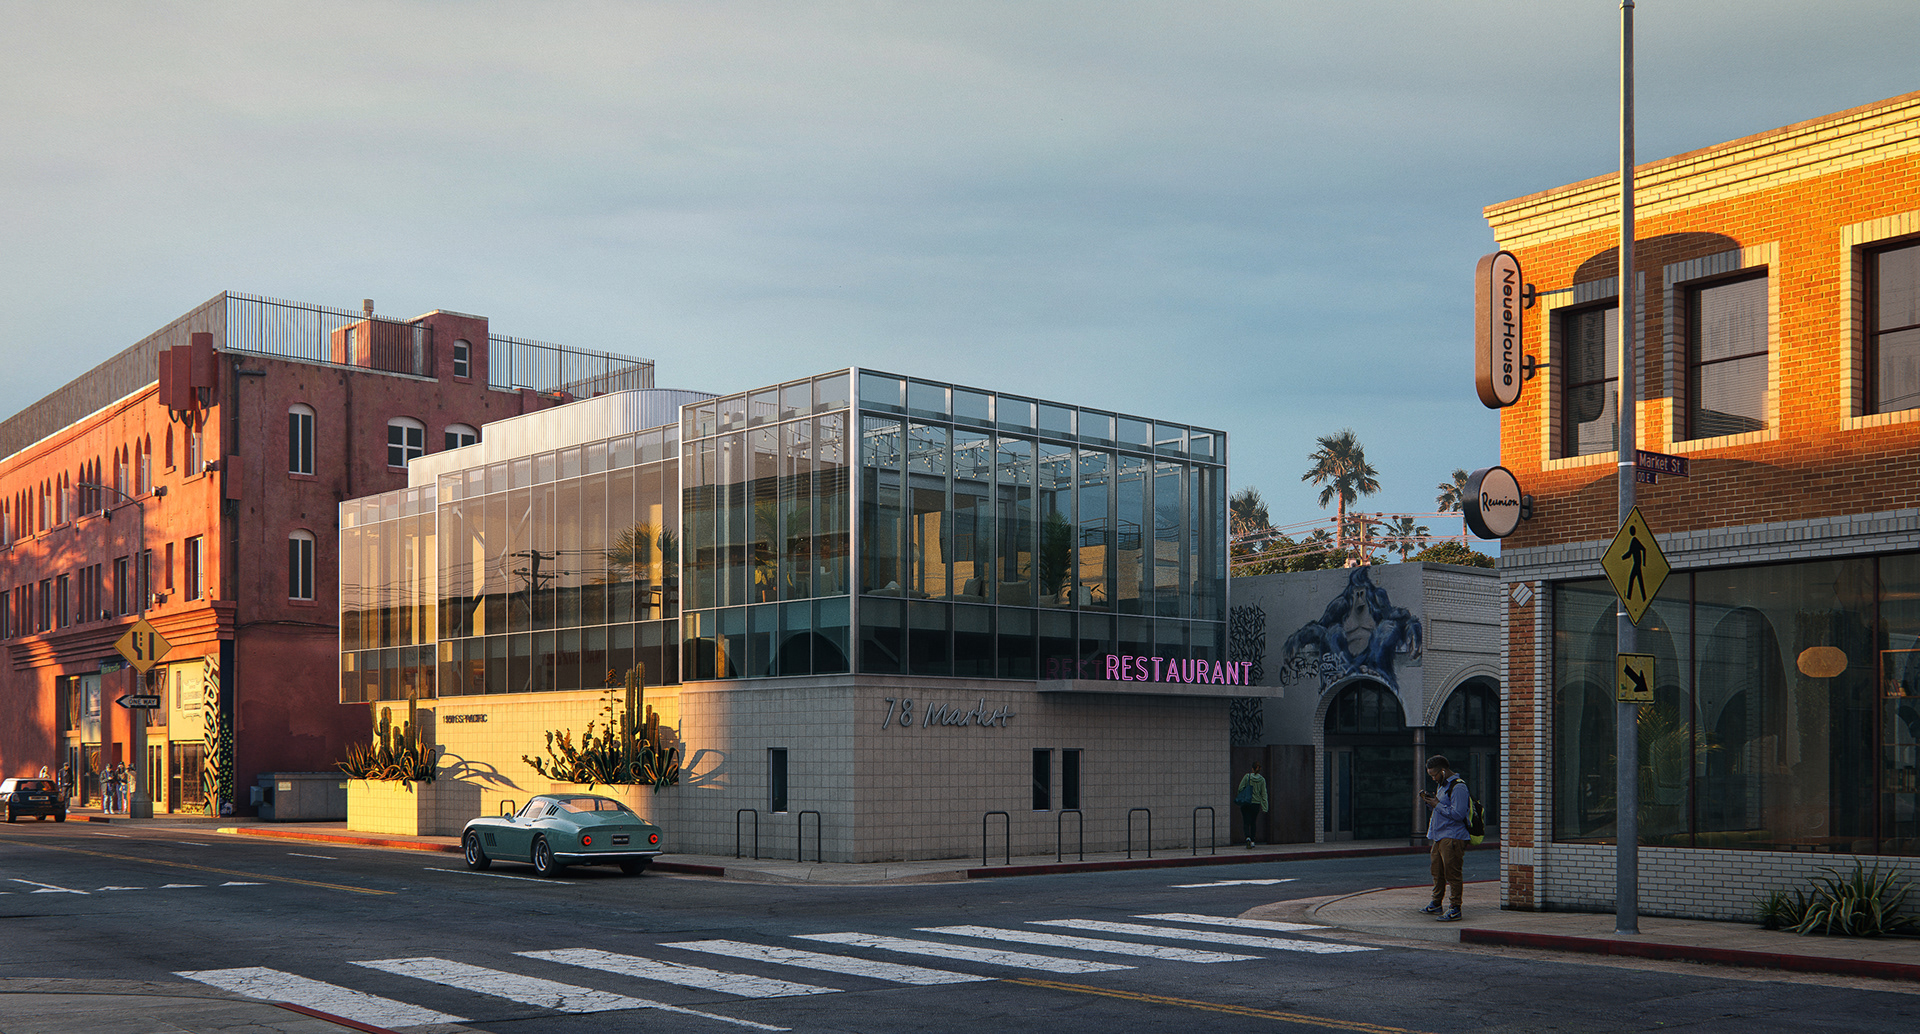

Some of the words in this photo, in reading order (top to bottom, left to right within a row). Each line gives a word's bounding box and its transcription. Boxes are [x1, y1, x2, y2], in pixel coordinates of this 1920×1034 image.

[1502, 268, 1516, 387] NeueHouse
[1639, 453, 1668, 470] Market
[1671, 458, 1681, 473] St
[1481, 491, 1520, 512] Reunion
[1106, 654, 1253, 685] RESTAURANT
[128, 698, 142, 706] ONE
[143, 698, 156, 706] WAY
[882, 697, 914, 730] 78
[923, 697, 1017, 729] Market
